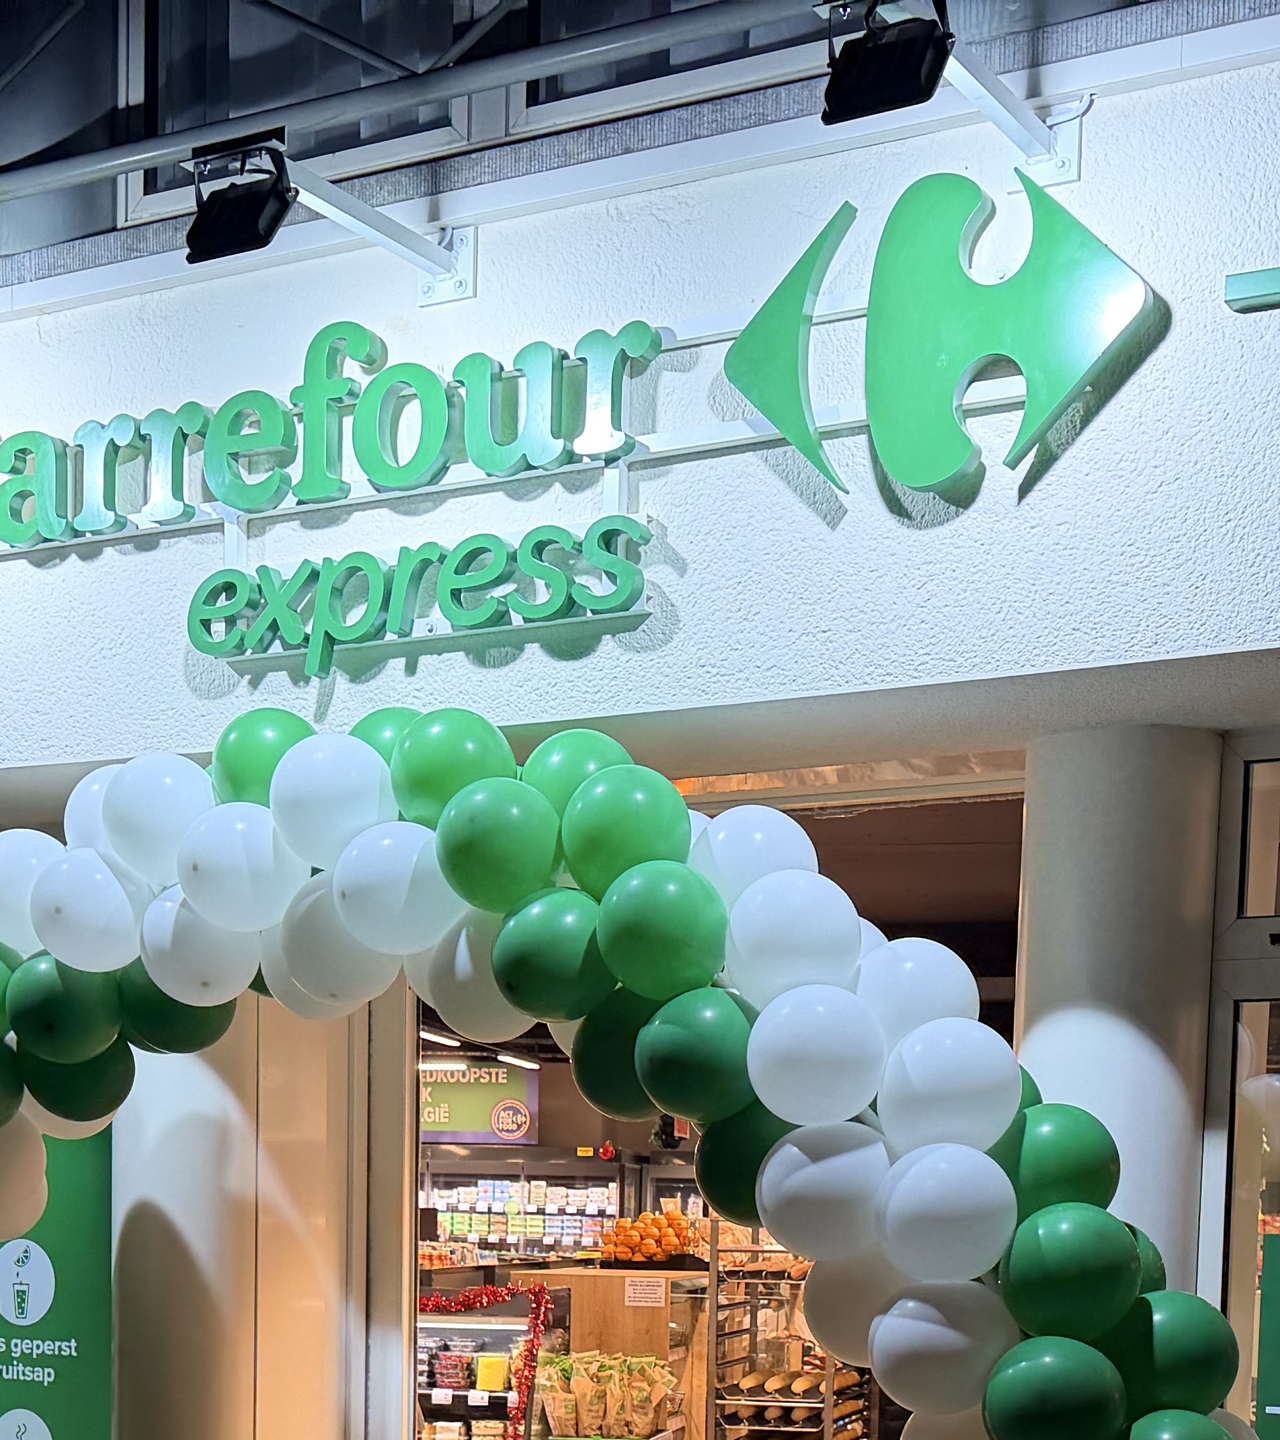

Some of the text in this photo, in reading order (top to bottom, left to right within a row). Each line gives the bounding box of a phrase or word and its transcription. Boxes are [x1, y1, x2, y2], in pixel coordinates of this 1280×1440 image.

[187, 515, 654, 679] express
[421, 1103, 450, 1122] GIË
[10, 1338, 78, 1359] geperst
